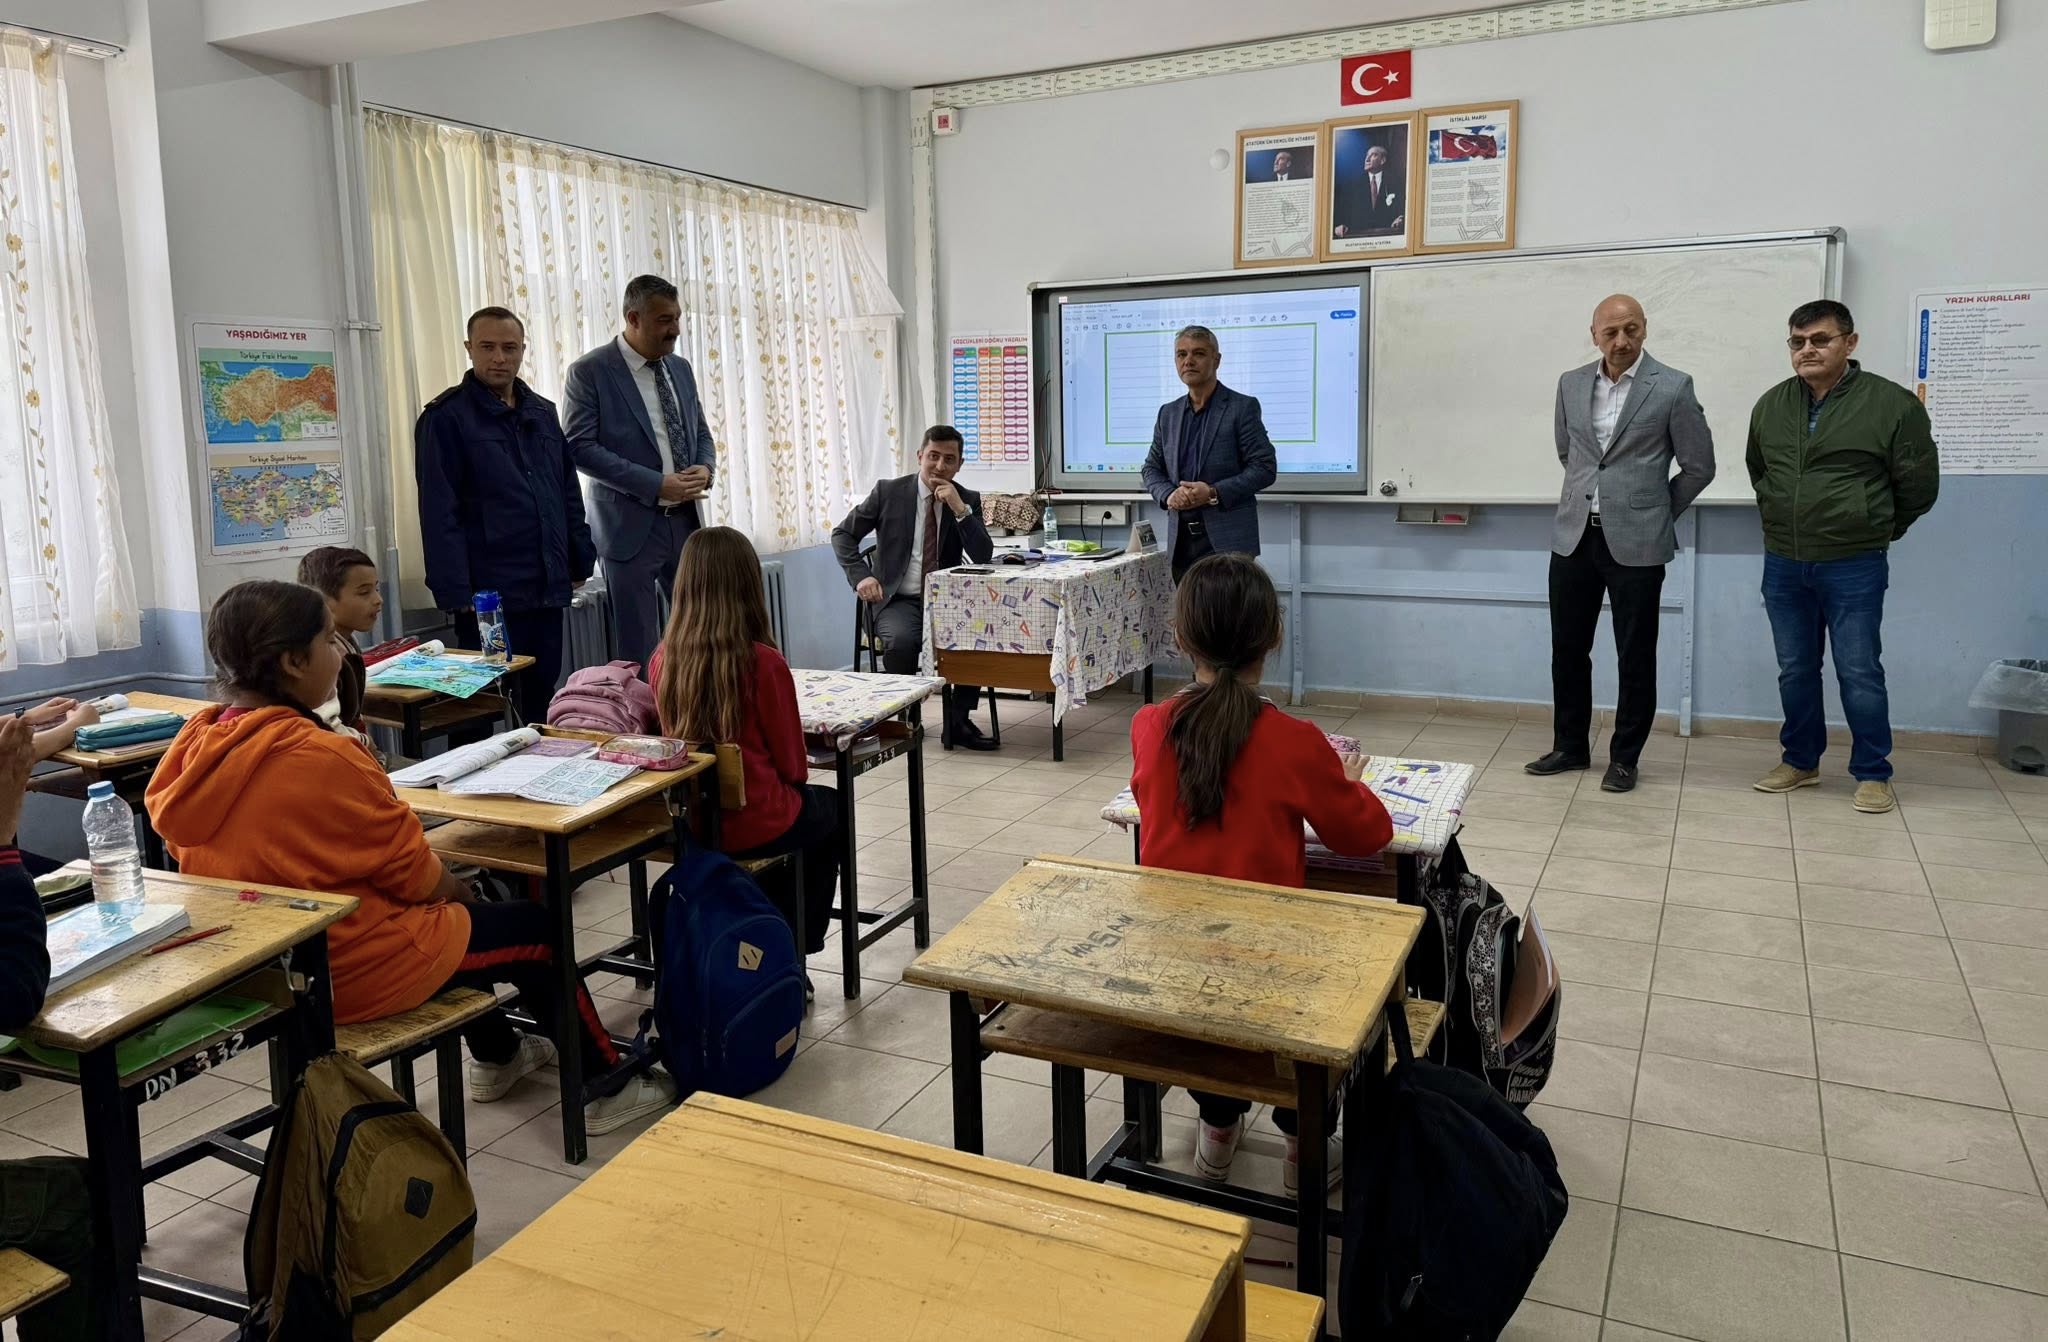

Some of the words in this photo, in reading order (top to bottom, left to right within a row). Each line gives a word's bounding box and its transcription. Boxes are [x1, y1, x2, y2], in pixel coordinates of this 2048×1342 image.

[1976, 293, 2031, 303] KURALLARI
[226, 329, 288, 341] YAŞADIĞIMIZ
[289, 332, 307, 340] YER
[1062, 913, 1135, 959] HASAN
[145, 1067, 177, 1101] DN
[195, 1032, 249, 1072] 332
